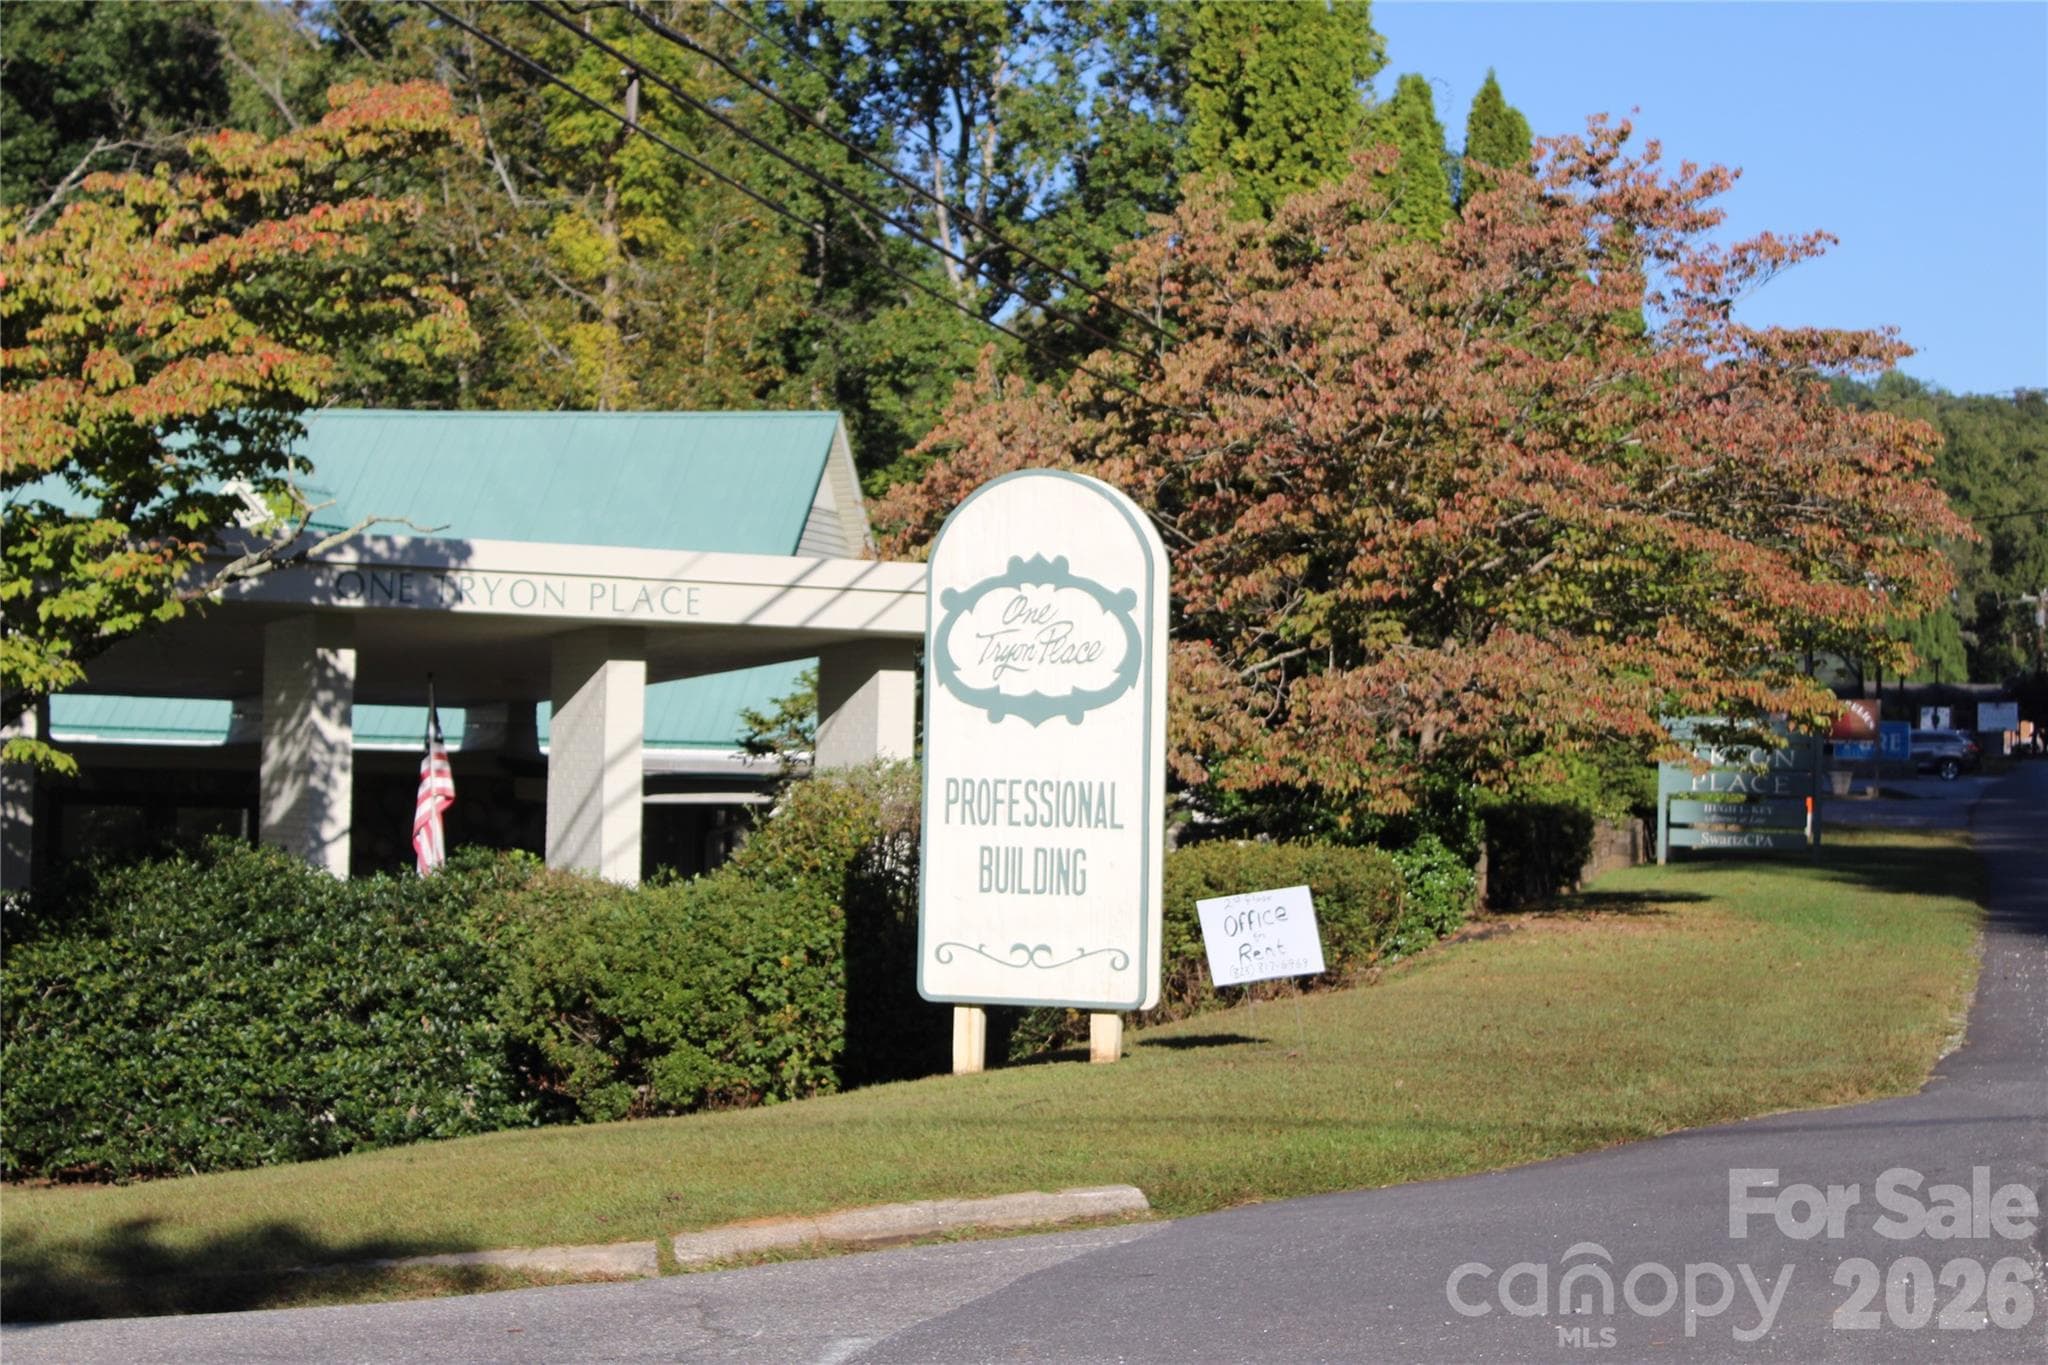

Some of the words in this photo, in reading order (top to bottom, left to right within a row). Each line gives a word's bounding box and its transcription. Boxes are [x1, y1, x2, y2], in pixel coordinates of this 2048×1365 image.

[335, 571, 413, 604] ONE
[432, 573, 566, 610] TRYON
[589, 583, 700, 616] PLACE
[1002, 594, 1058, 625] One
[976, 628, 1035, 681] Tryon
[1035, 620, 1104, 665] Place
[945, 777, 1124, 829] PROFESSIONAL
[1691, 773, 1791, 795] PLACE
[979, 845, 1087, 896] BUILDING
[1238, 939, 1287, 966] Rent
